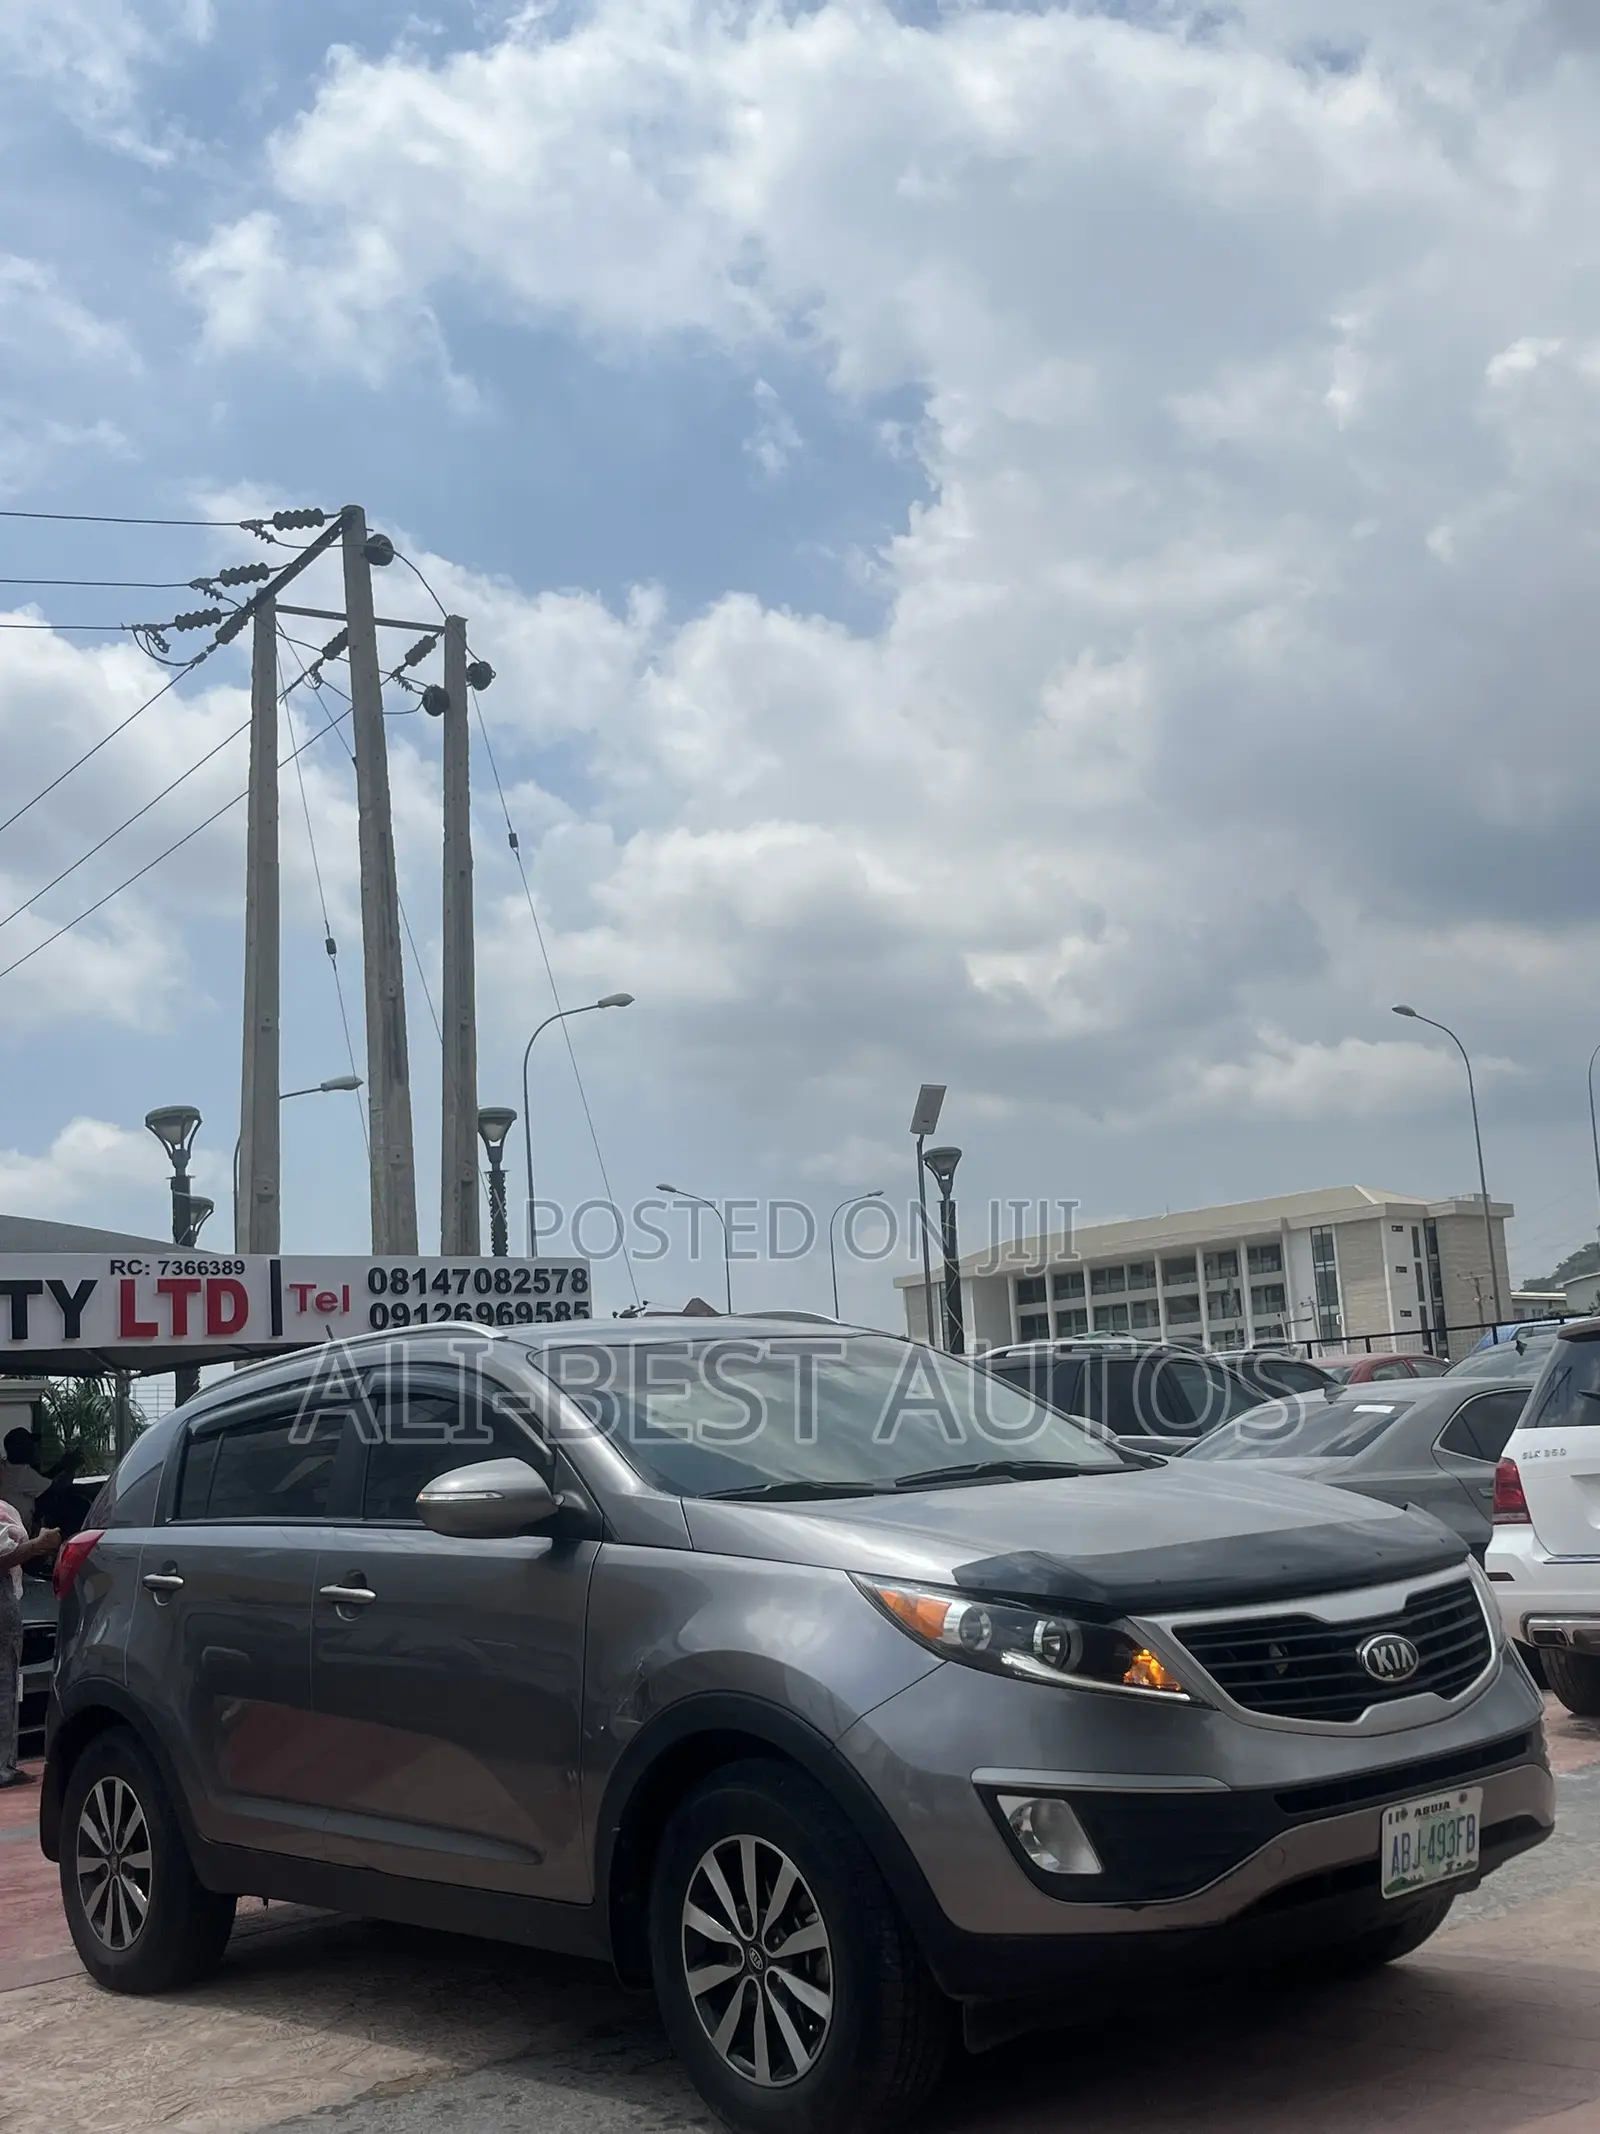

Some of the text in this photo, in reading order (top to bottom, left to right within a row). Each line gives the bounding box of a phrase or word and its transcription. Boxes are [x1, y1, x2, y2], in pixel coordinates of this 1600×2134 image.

[110, 1260, 245, 1275] RC: 7366389
[368, 1267, 588, 1294] 08147082578
[0, 1278, 249, 1340] TY LTD
[288, 1283, 350, 1312] Tel
[369, 1301, 590, 1330] 09126969585
[1372, 1643, 1414, 1672] KIA
